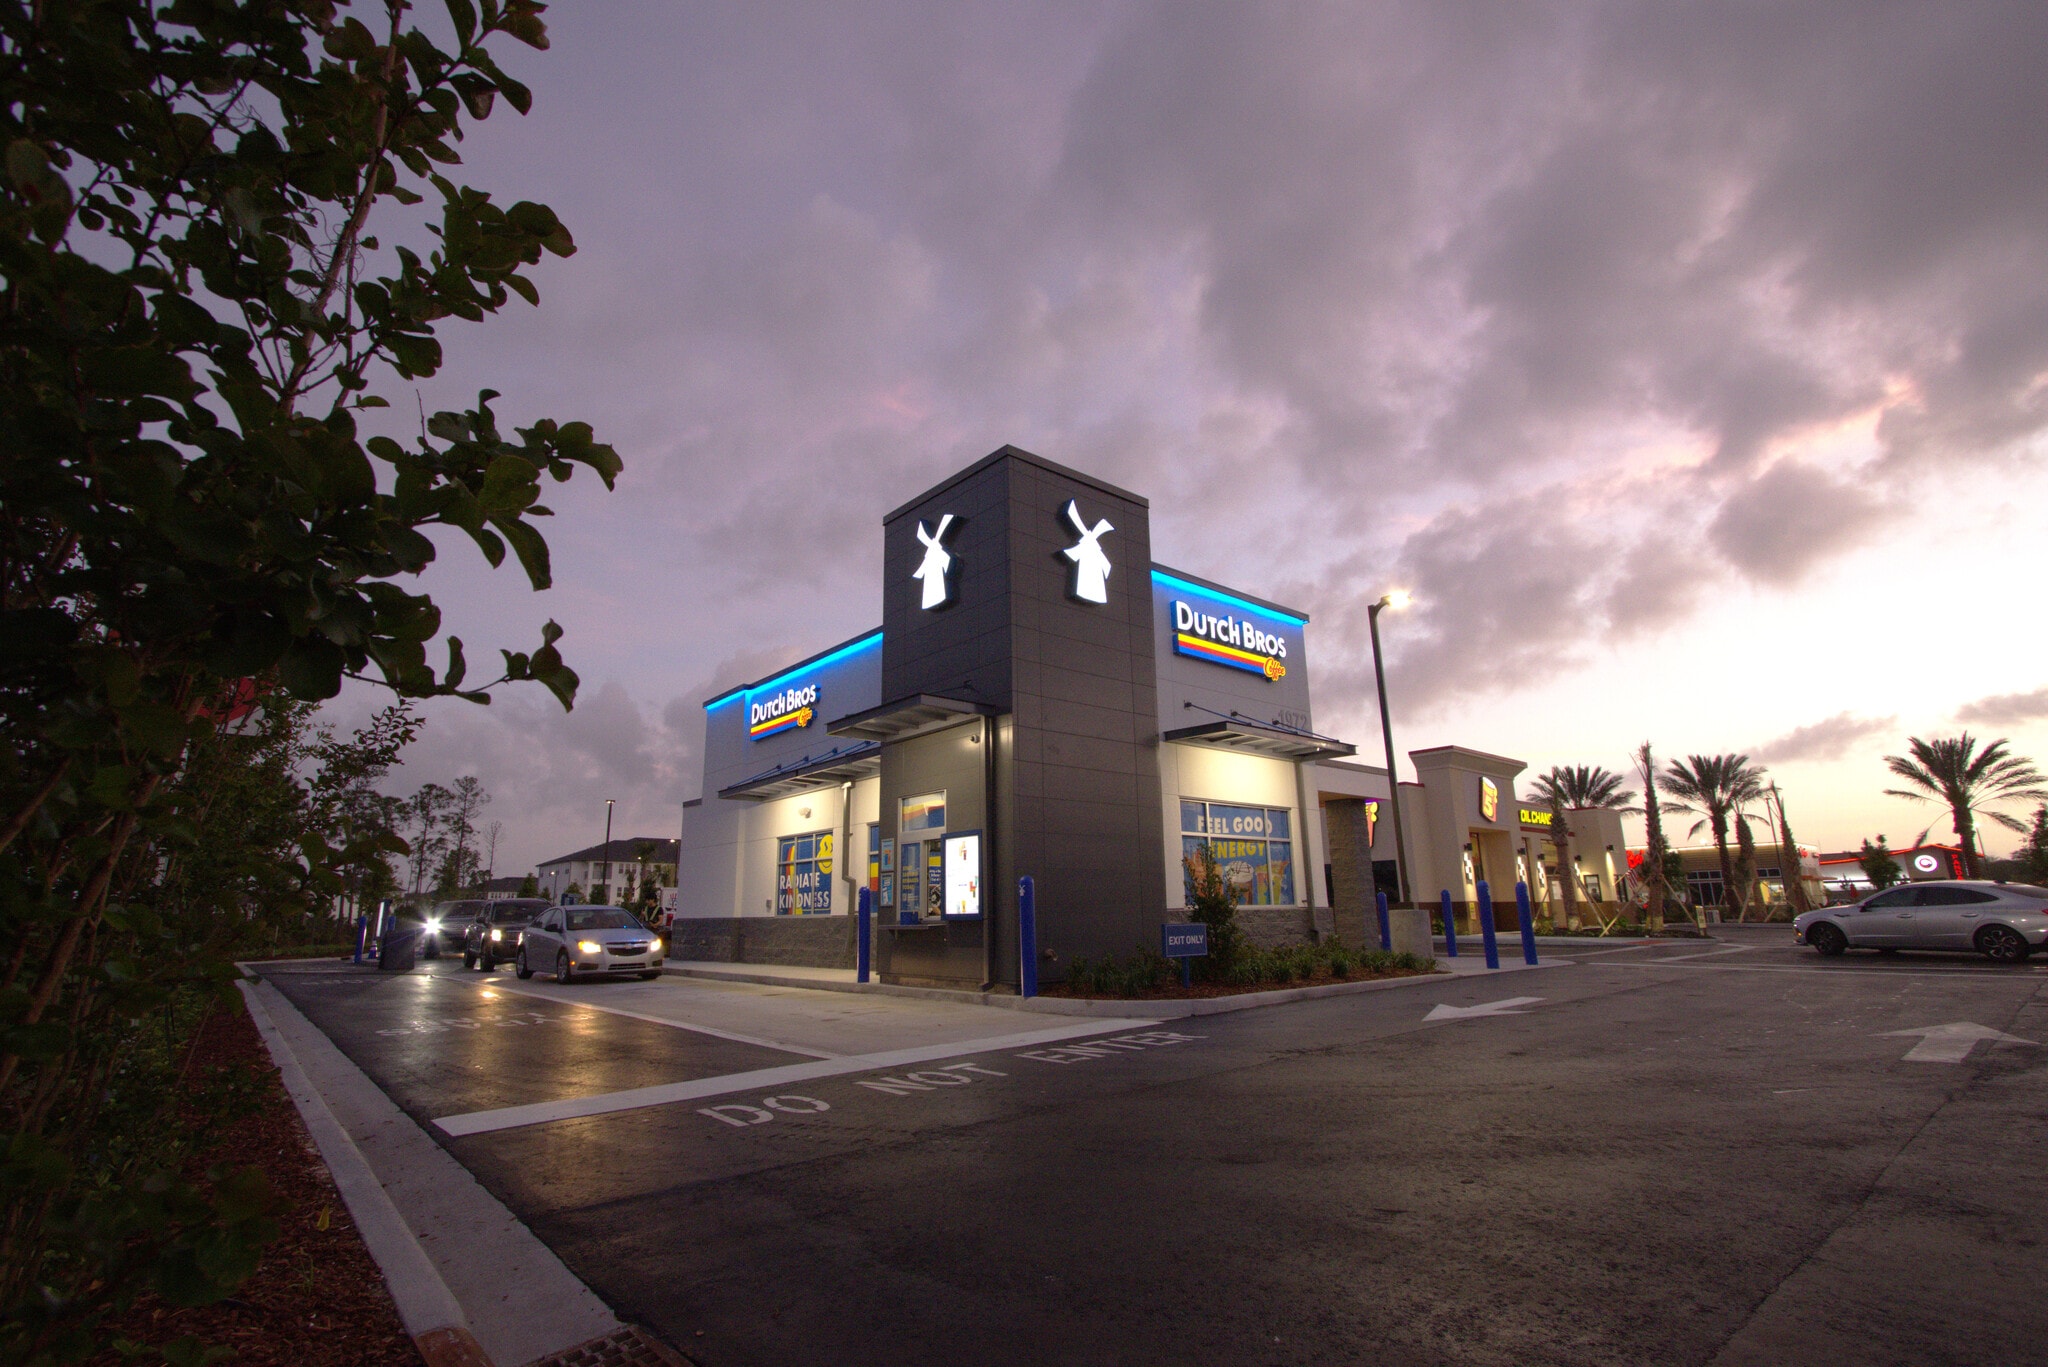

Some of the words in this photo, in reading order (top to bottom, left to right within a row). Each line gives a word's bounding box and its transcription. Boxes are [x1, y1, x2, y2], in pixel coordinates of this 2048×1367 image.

[1176, 600, 1240, 645] DUTCH
[1242, 620, 1287, 658] BROS
[751, 692, 785, 725] DUTCH
[786, 684, 816, 712] BROS
[1197, 815, 1230, 834] FEEL
[1233, 816, 1273, 835] GOOD
[1520, 809, 1531, 823] OIL
[1168, 935, 1186, 946] EXIT
[1186, 934, 1204, 945] ONLY
[696, 1095, 831, 1127] DO
[853, 1062, 1008, 1096] NOT
[1013, 1031, 1210, 1065] ENTER
